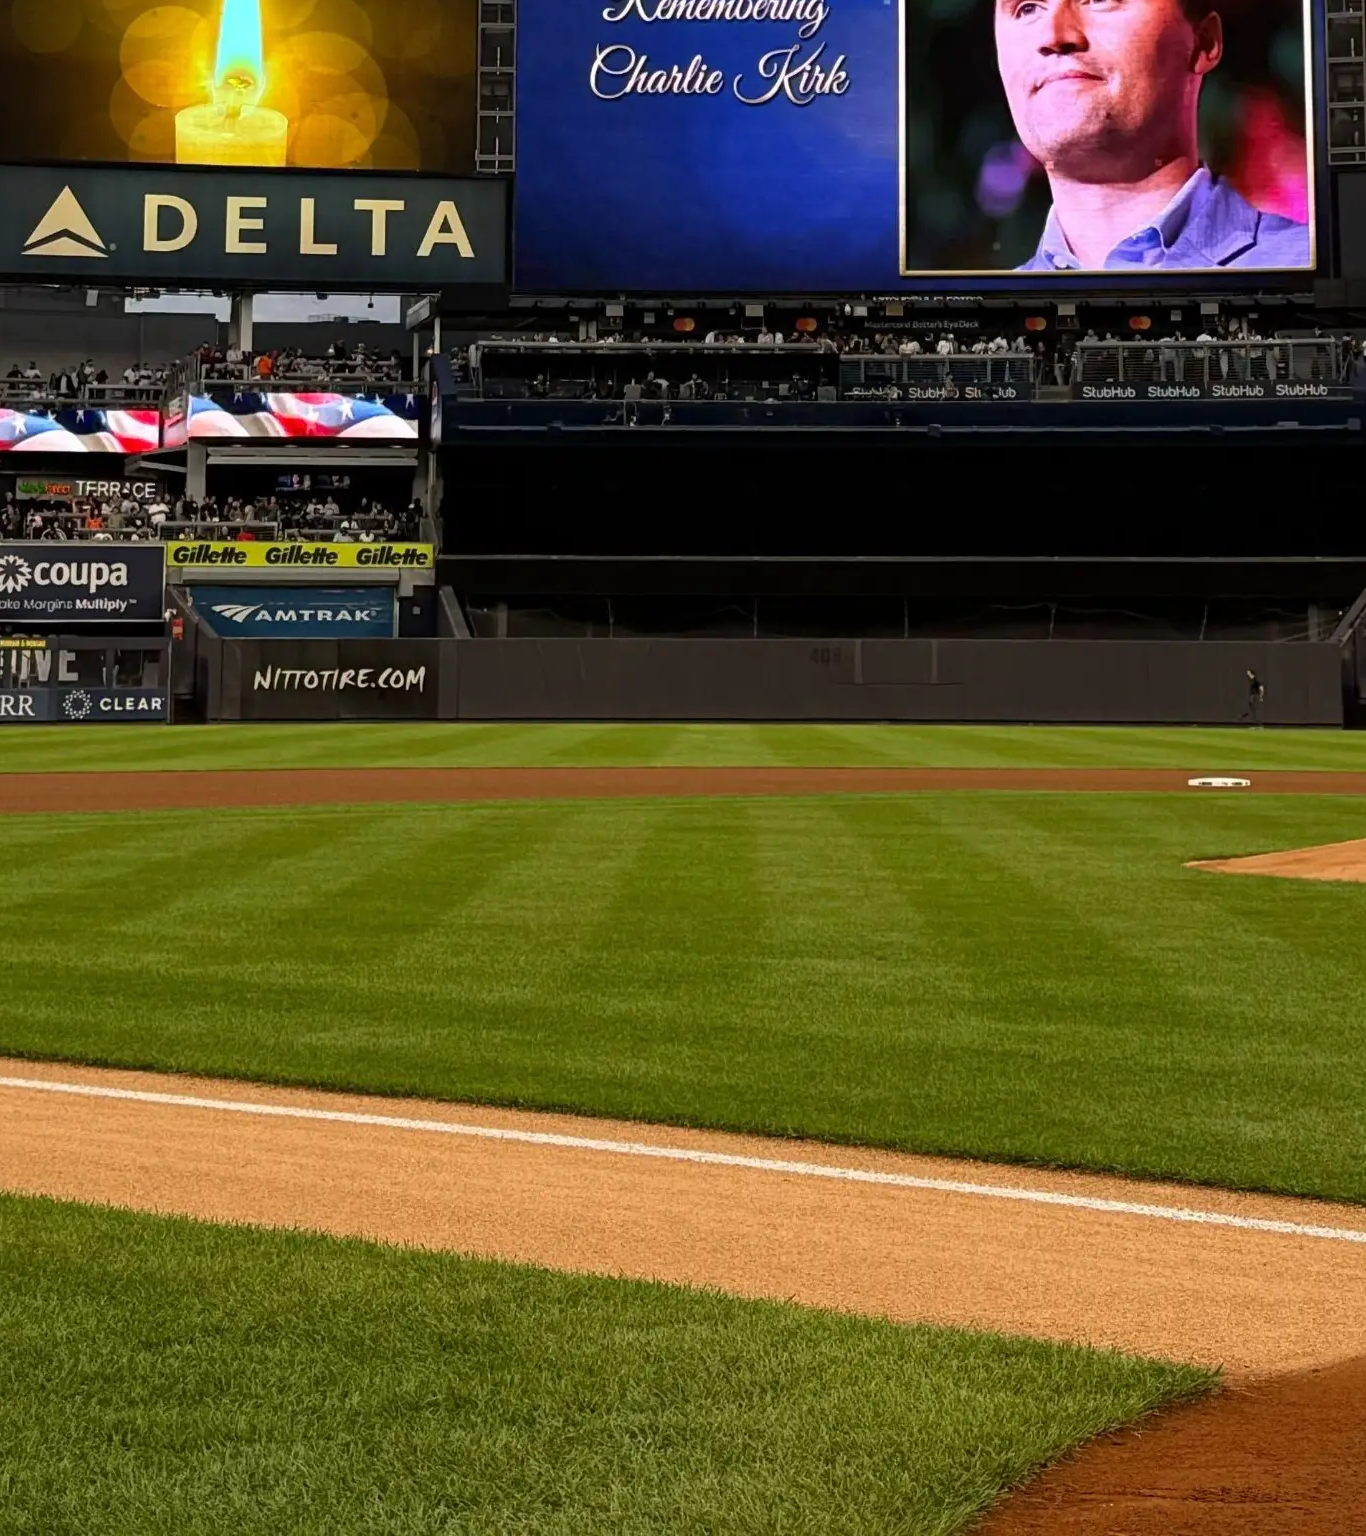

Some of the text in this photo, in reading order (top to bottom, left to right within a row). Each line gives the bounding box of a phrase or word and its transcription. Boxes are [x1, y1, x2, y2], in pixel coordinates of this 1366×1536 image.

[589, 41, 850, 106] Charlie Kirk
[143, 194, 476, 259] DELTA
[1082, 386, 1136, 399] StubHub
[1147, 385, 1200, 398] StubHub
[1211, 384, 1264, 397] StubHub
[1275, 383, 1328, 396] StubHub
[173, 544, 247, 565] Gillette
[265, 545, 338, 566] Gillette
[356, 546, 429, 567] Gillette
[33, 561, 128, 594] coupa
[23, 599, 73, 613] Margins
[255, 609, 372, 622] AMTRAK
[253, 664, 427, 693] NITTOTIRE.COM
[99, 697, 164, 711] CLEAR
